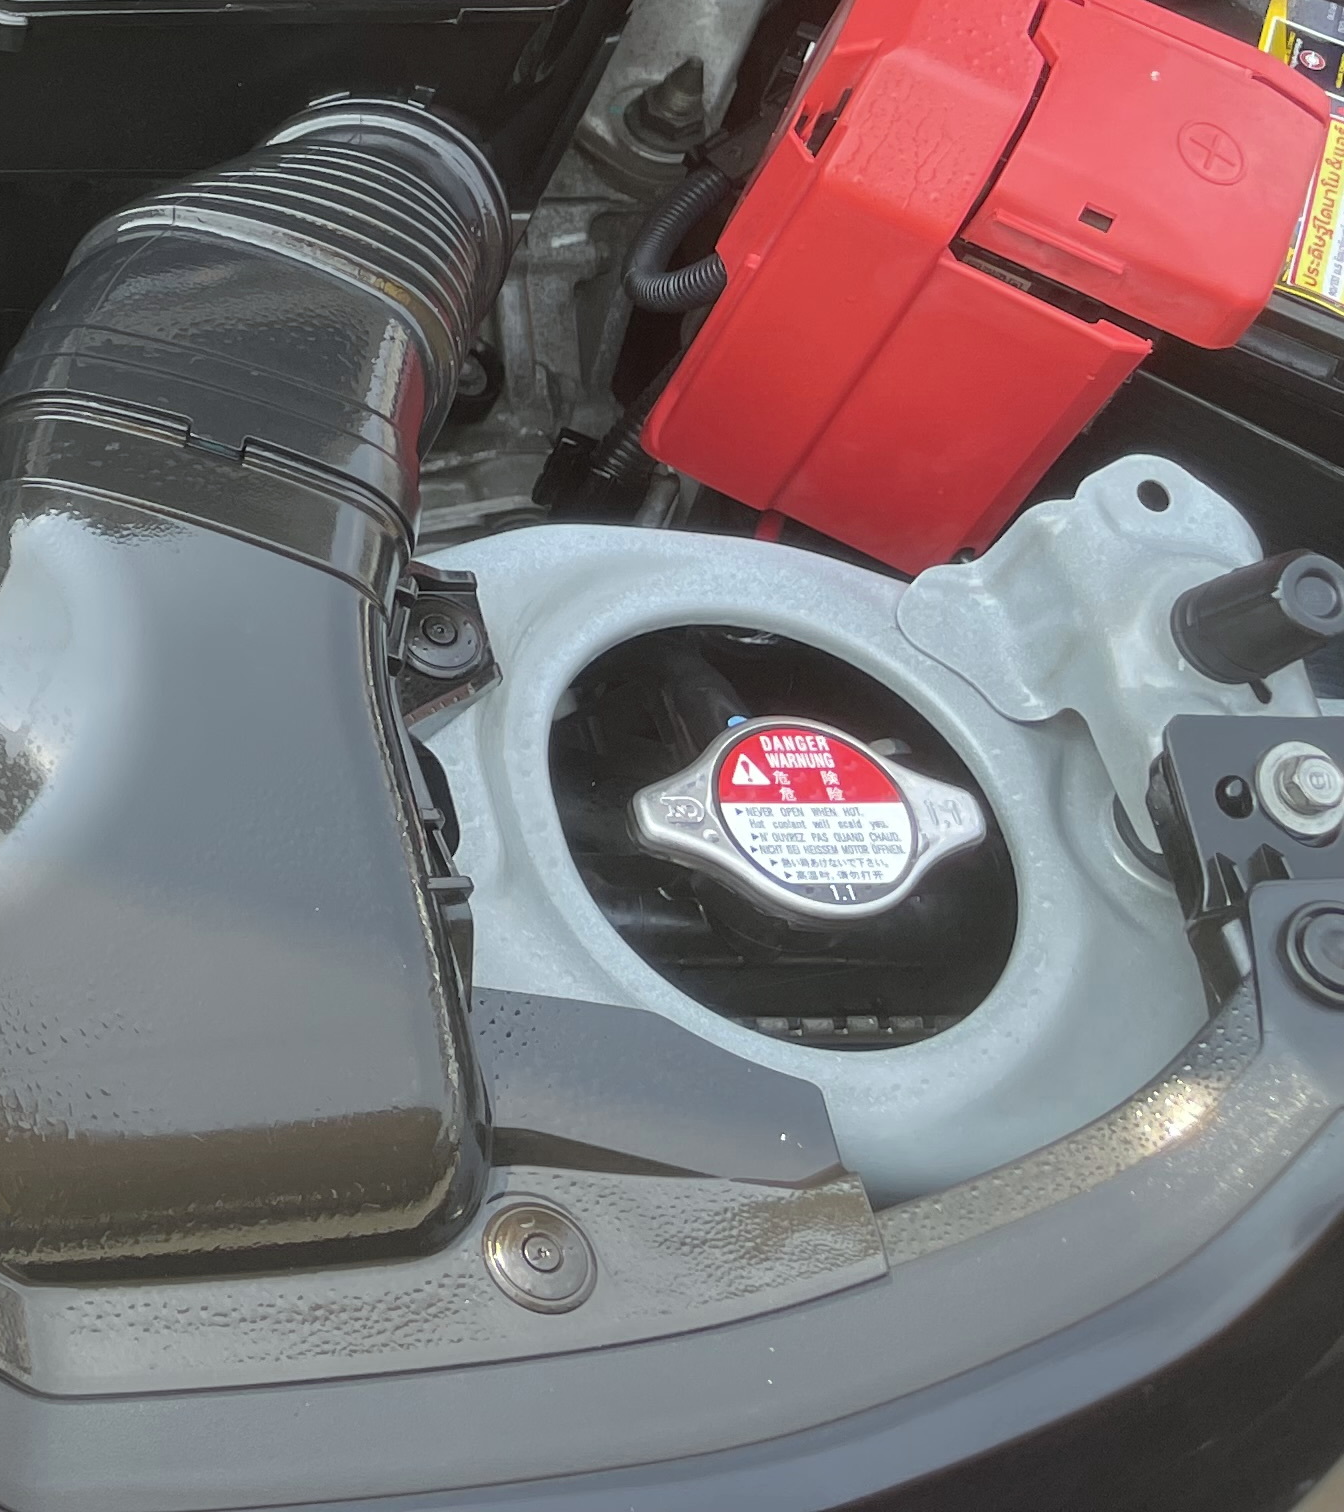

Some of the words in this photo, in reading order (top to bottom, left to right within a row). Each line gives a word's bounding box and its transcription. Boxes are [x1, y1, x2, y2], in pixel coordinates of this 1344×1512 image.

[759, 735, 830, 752] DANGER
[764, 752, 836, 769] WARNUNG
[745, 807, 774, 818] NEVER
[780, 807, 805, 818] OPEN
[811, 807, 838, 818] WHEN
[748, 819, 766, 829] Hot
[773, 819, 807, 830] coolant
[813, 819, 831, 829] will
[811, 832, 829, 843] PAS
[833, 832, 865, 843] QUAND
[759, 844, 784, 855] NICHT
[786, 844, 801, 855] BEI
[803, 844, 839, 855] HEISSEM
[840, 844, 869, 855] MOTOR
[830, 884, 857, 901] 1.1
